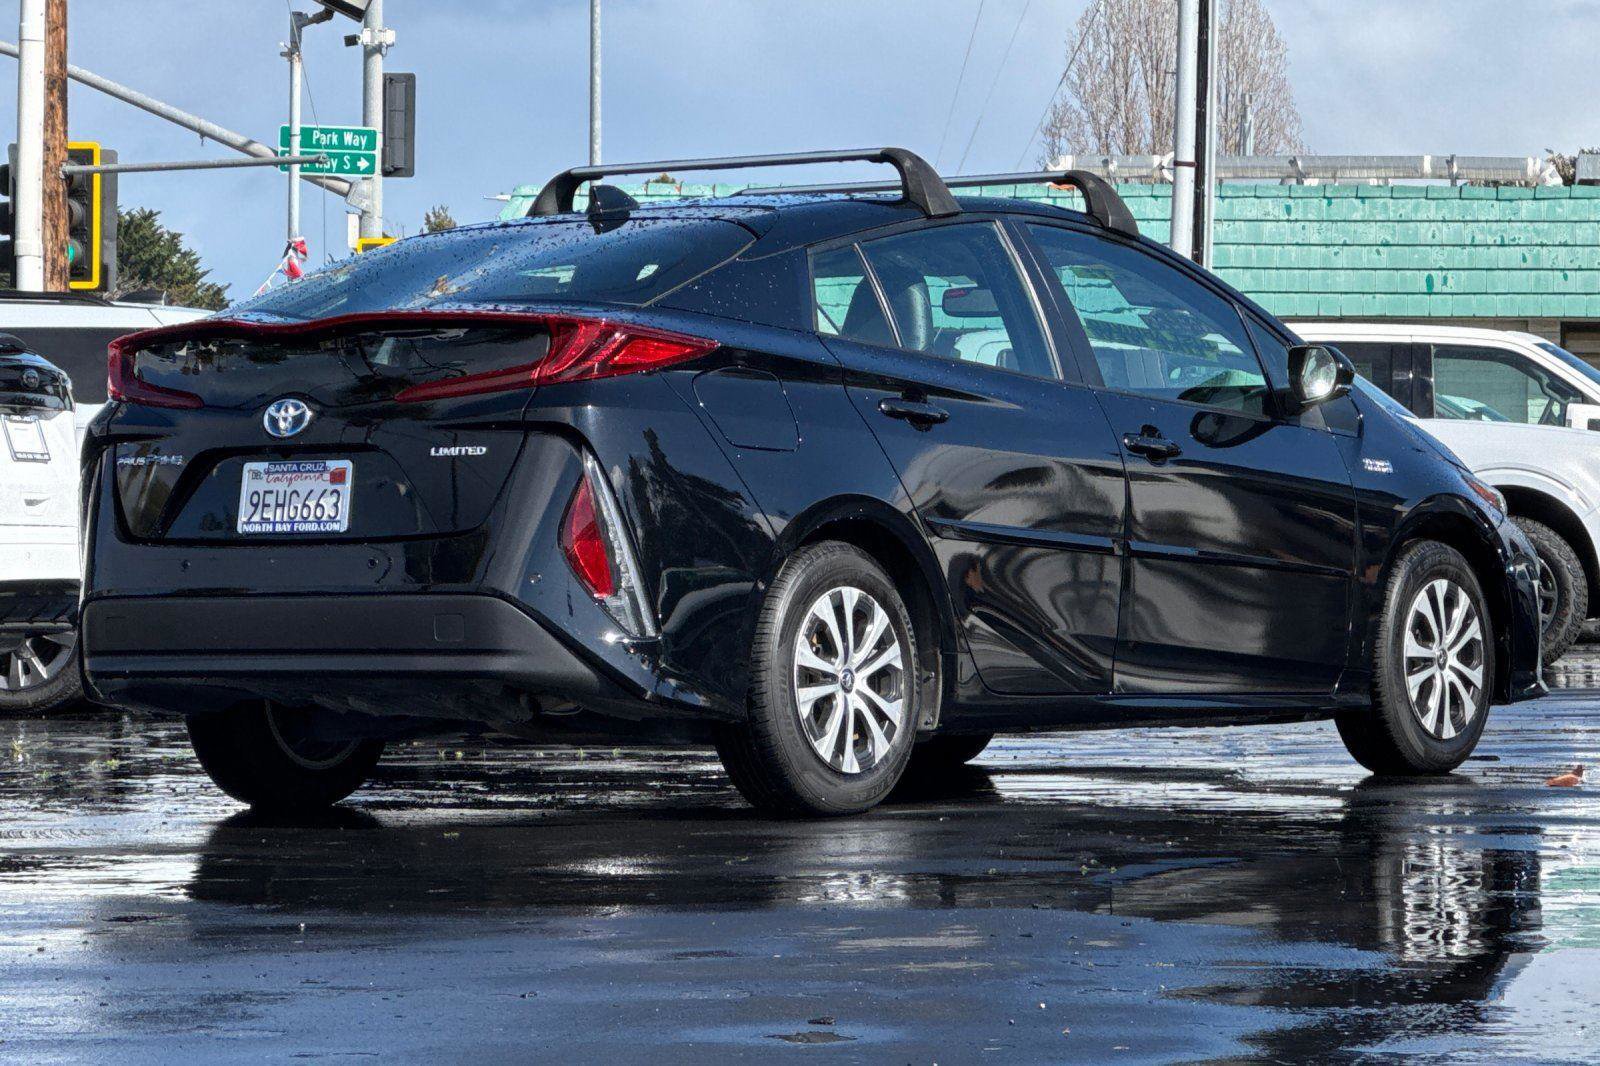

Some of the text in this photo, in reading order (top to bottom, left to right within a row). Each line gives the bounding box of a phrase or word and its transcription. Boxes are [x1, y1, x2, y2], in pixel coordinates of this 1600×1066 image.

[312, 130, 367, 150] Park Way
[343, 155, 351, 170] S
[430, 446, 487, 456] LIMITED
[268, 462, 325, 472] SANTA CRUZ
[248, 488, 341, 522] 9EHG663
[242, 521, 341, 532] NORTH BAY FORD.COM
